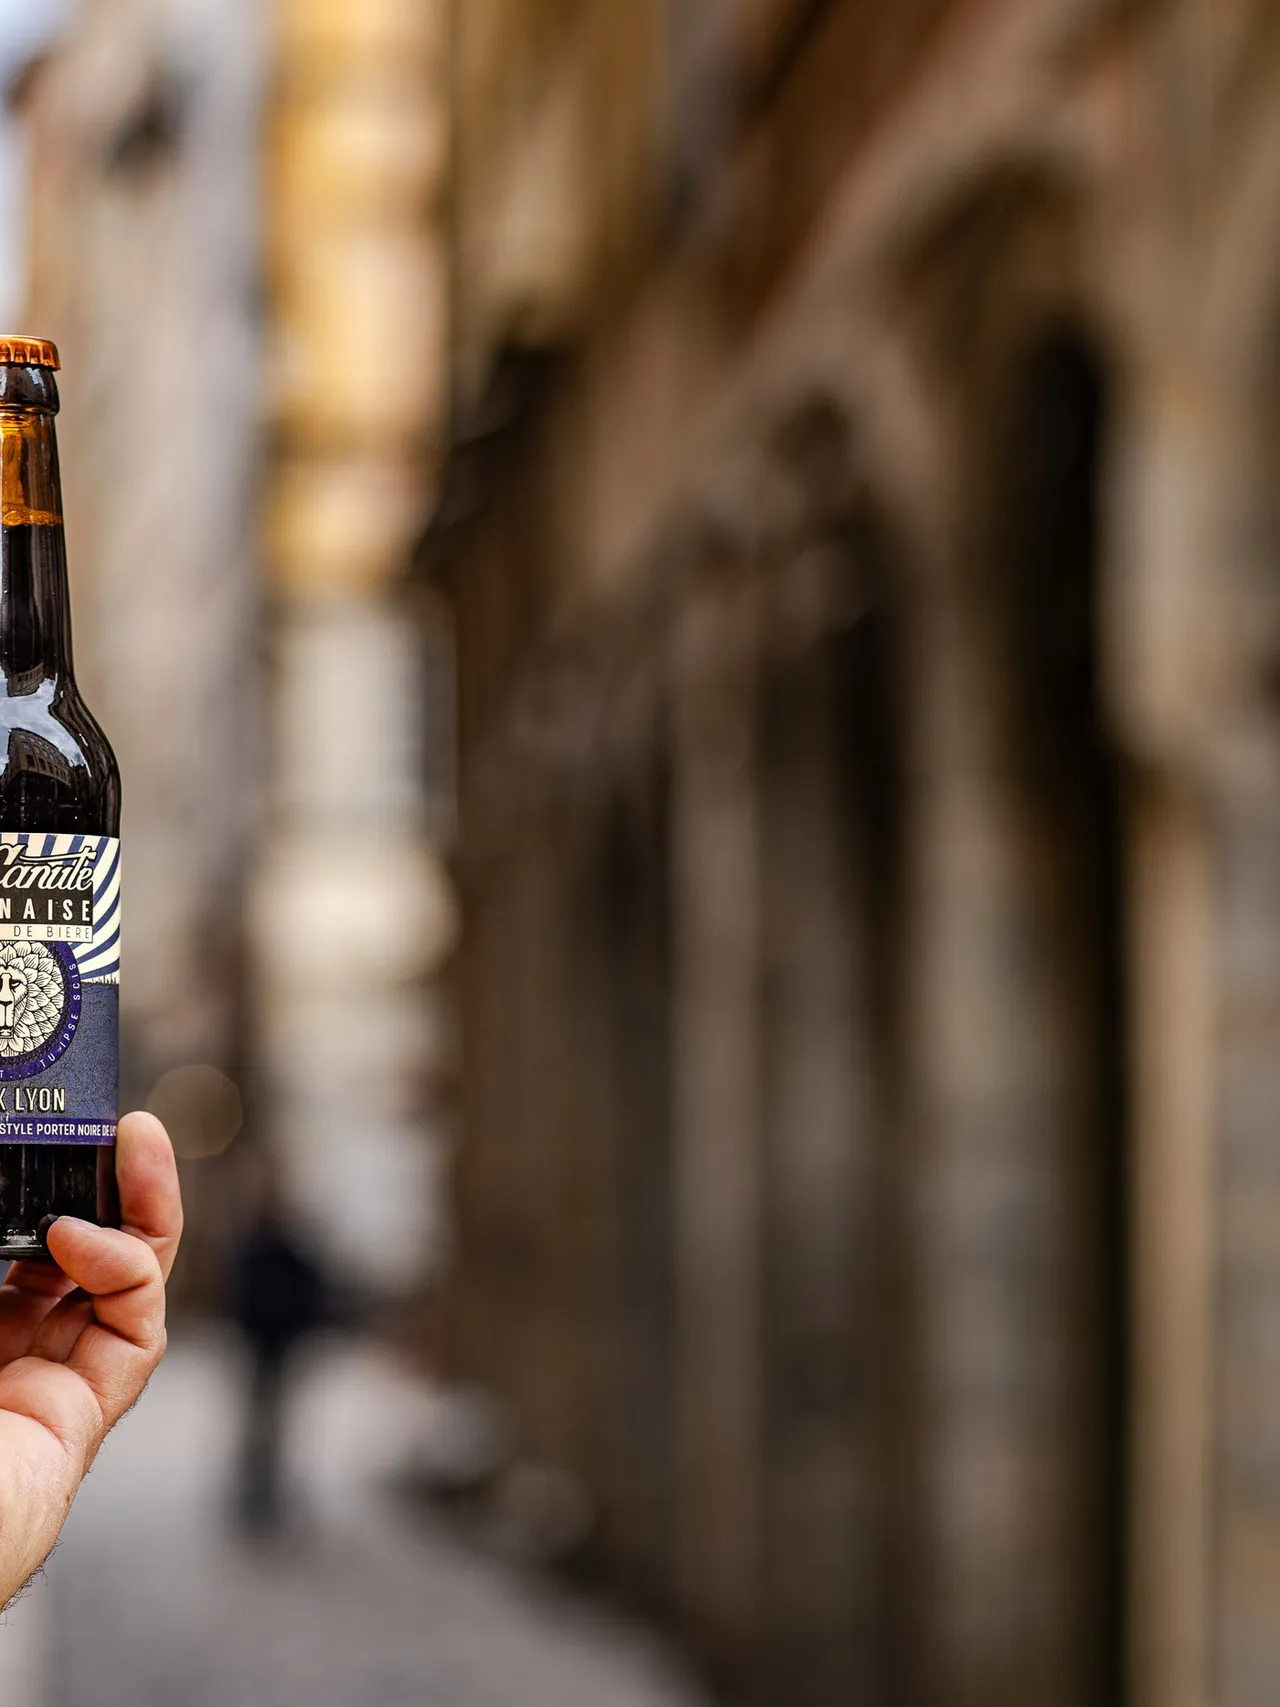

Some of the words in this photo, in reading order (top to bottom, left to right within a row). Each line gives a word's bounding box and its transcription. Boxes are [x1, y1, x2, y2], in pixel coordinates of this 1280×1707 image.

[13, 925, 34, 938] DE
[46, 926, 91, 939] BIERE
[68, 963, 81, 1001] SCIS
[60, 1013, 79, 1049] IPSE
[41, 1053, 56, 1069] TU
[15, 1087, 65, 1112] LYON
[0, 1123, 33, 1135] STYLE
[37, 1123, 75, 1136] PORTER
[78, 1123, 101, 1136] NOIRE
